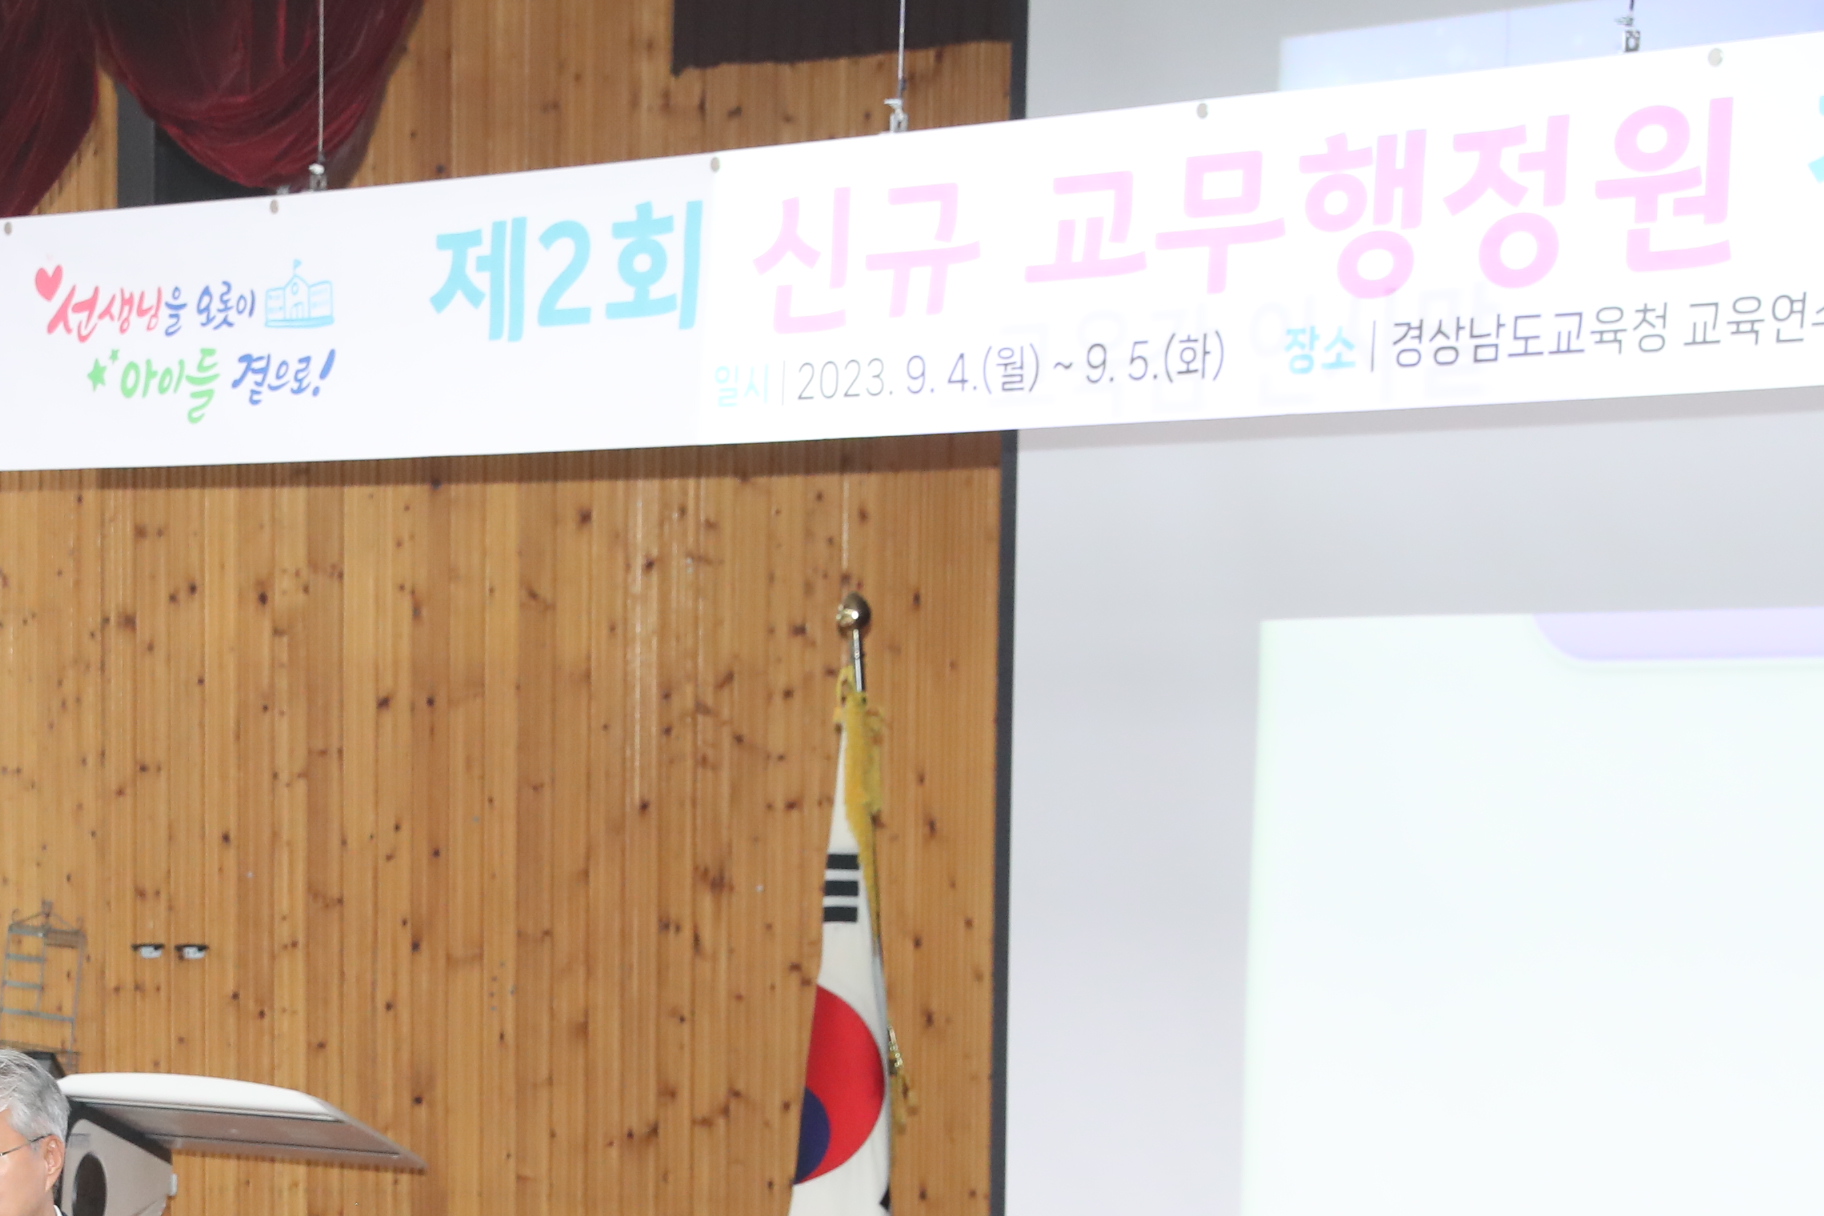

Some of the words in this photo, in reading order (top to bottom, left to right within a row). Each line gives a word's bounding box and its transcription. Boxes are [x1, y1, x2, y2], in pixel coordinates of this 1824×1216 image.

[429, 200, 704, 342] 제2회
[752, 182, 982, 335] 신규
[1024, 97, 1735, 299] 교무행정원
[46, 284, 188, 344] 선생님을
[196, 280, 256, 330] 오롯이
[1283, 324, 1357, 375] 장소
[1392, 301, 1668, 369] 경상남도교육청
[120, 348, 221, 424] 아이들
[231, 348, 336, 406] 곁으로!
[714, 362, 771, 407] 일시
